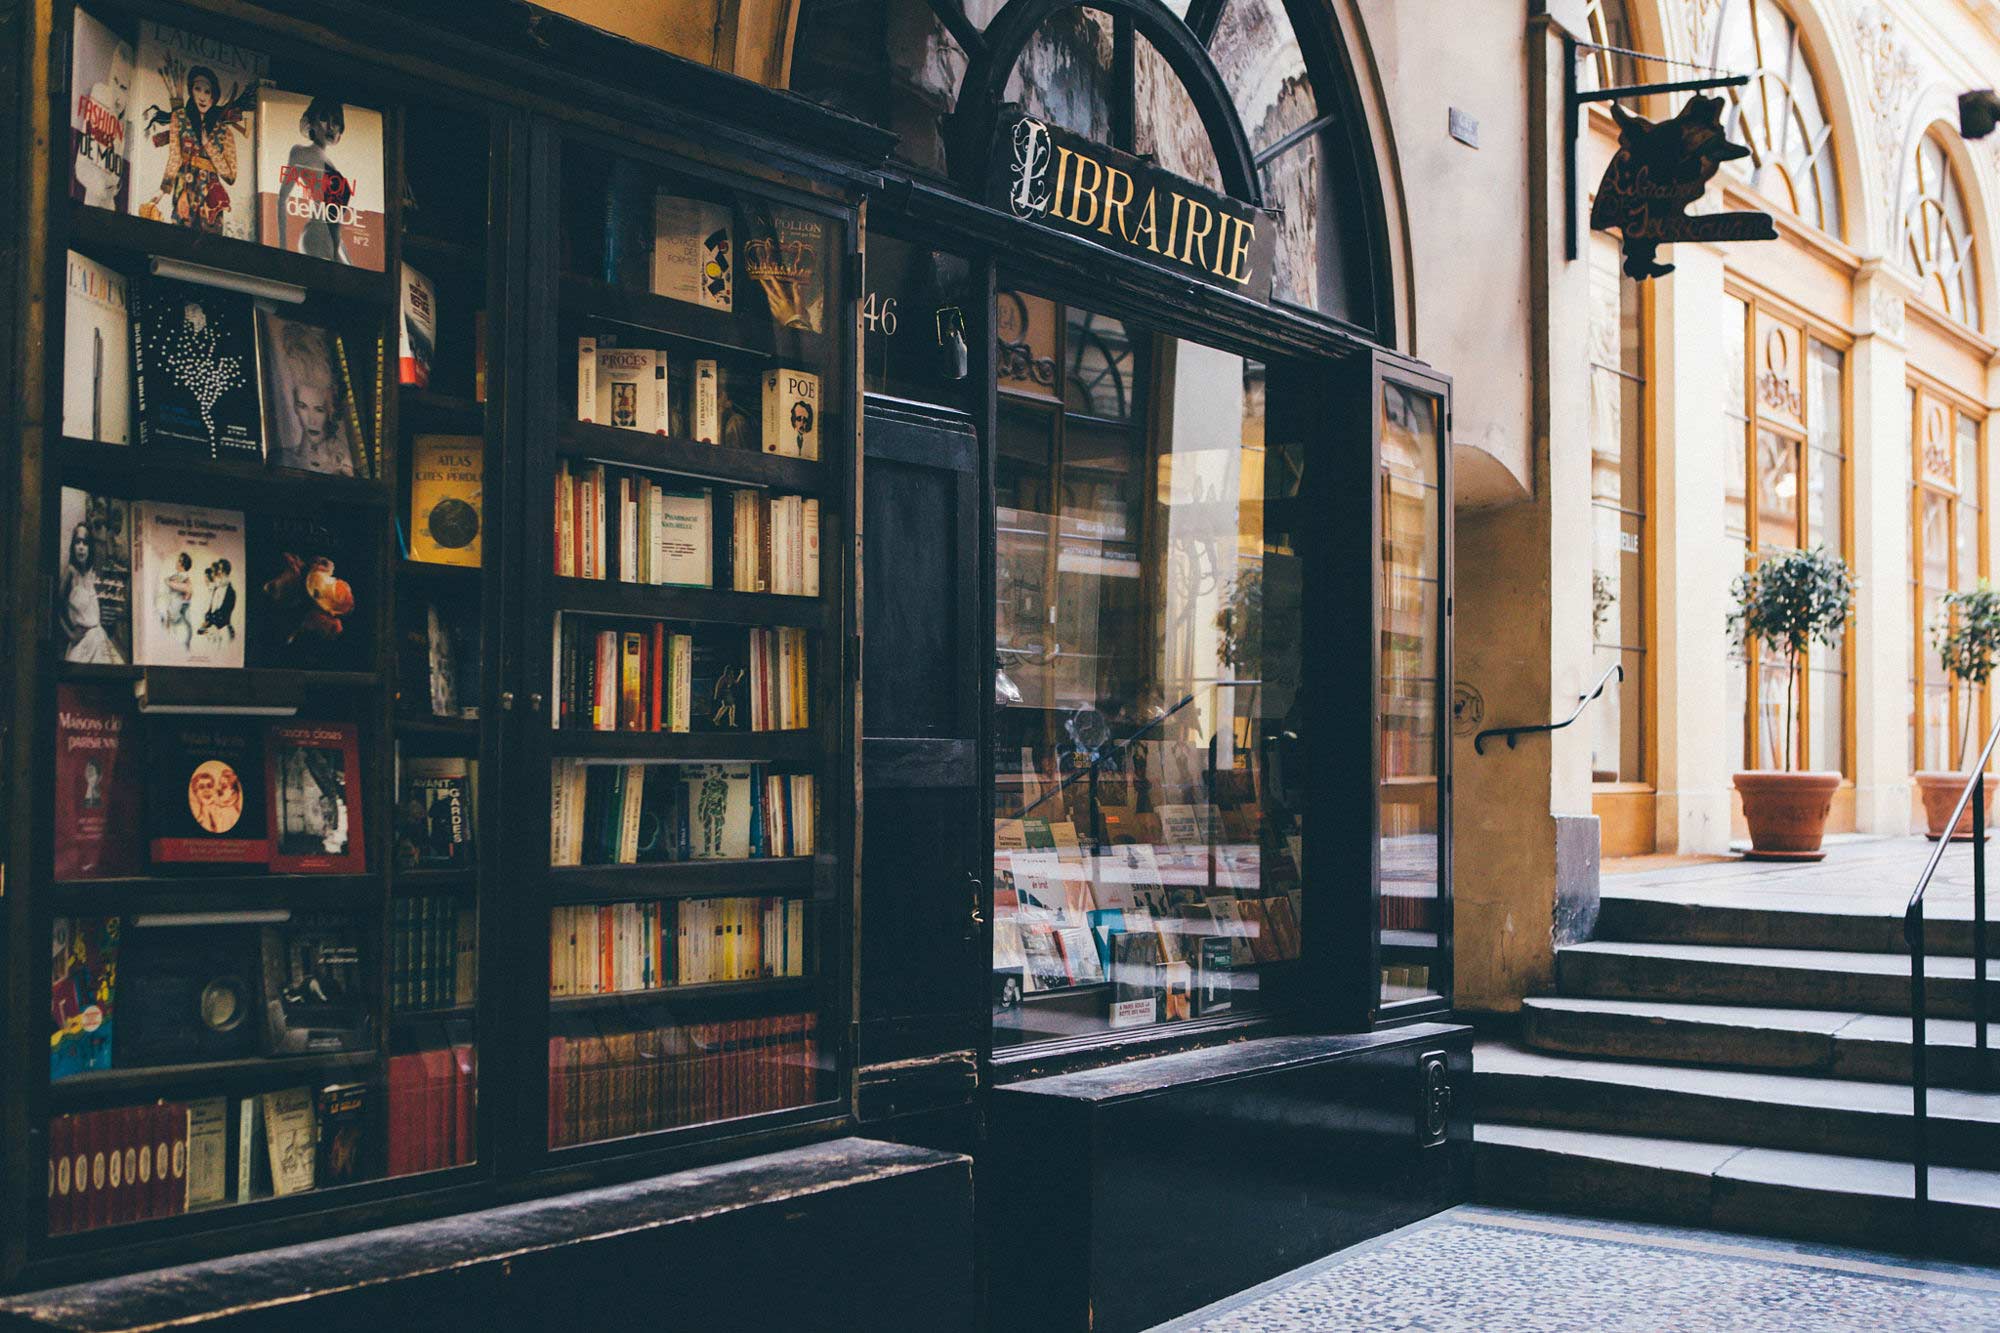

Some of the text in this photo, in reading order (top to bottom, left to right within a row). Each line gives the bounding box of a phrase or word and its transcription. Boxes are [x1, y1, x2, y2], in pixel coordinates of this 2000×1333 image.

[78, 95, 124, 142] FASHION
[280, 165, 356, 197] FASHION
[1010, 116, 1256, 285] LIBRAIRIE
[863, 292, 897, 335] 46
[788, 377, 815, 398] POE
[438, 455, 472, 467] ATLAS
